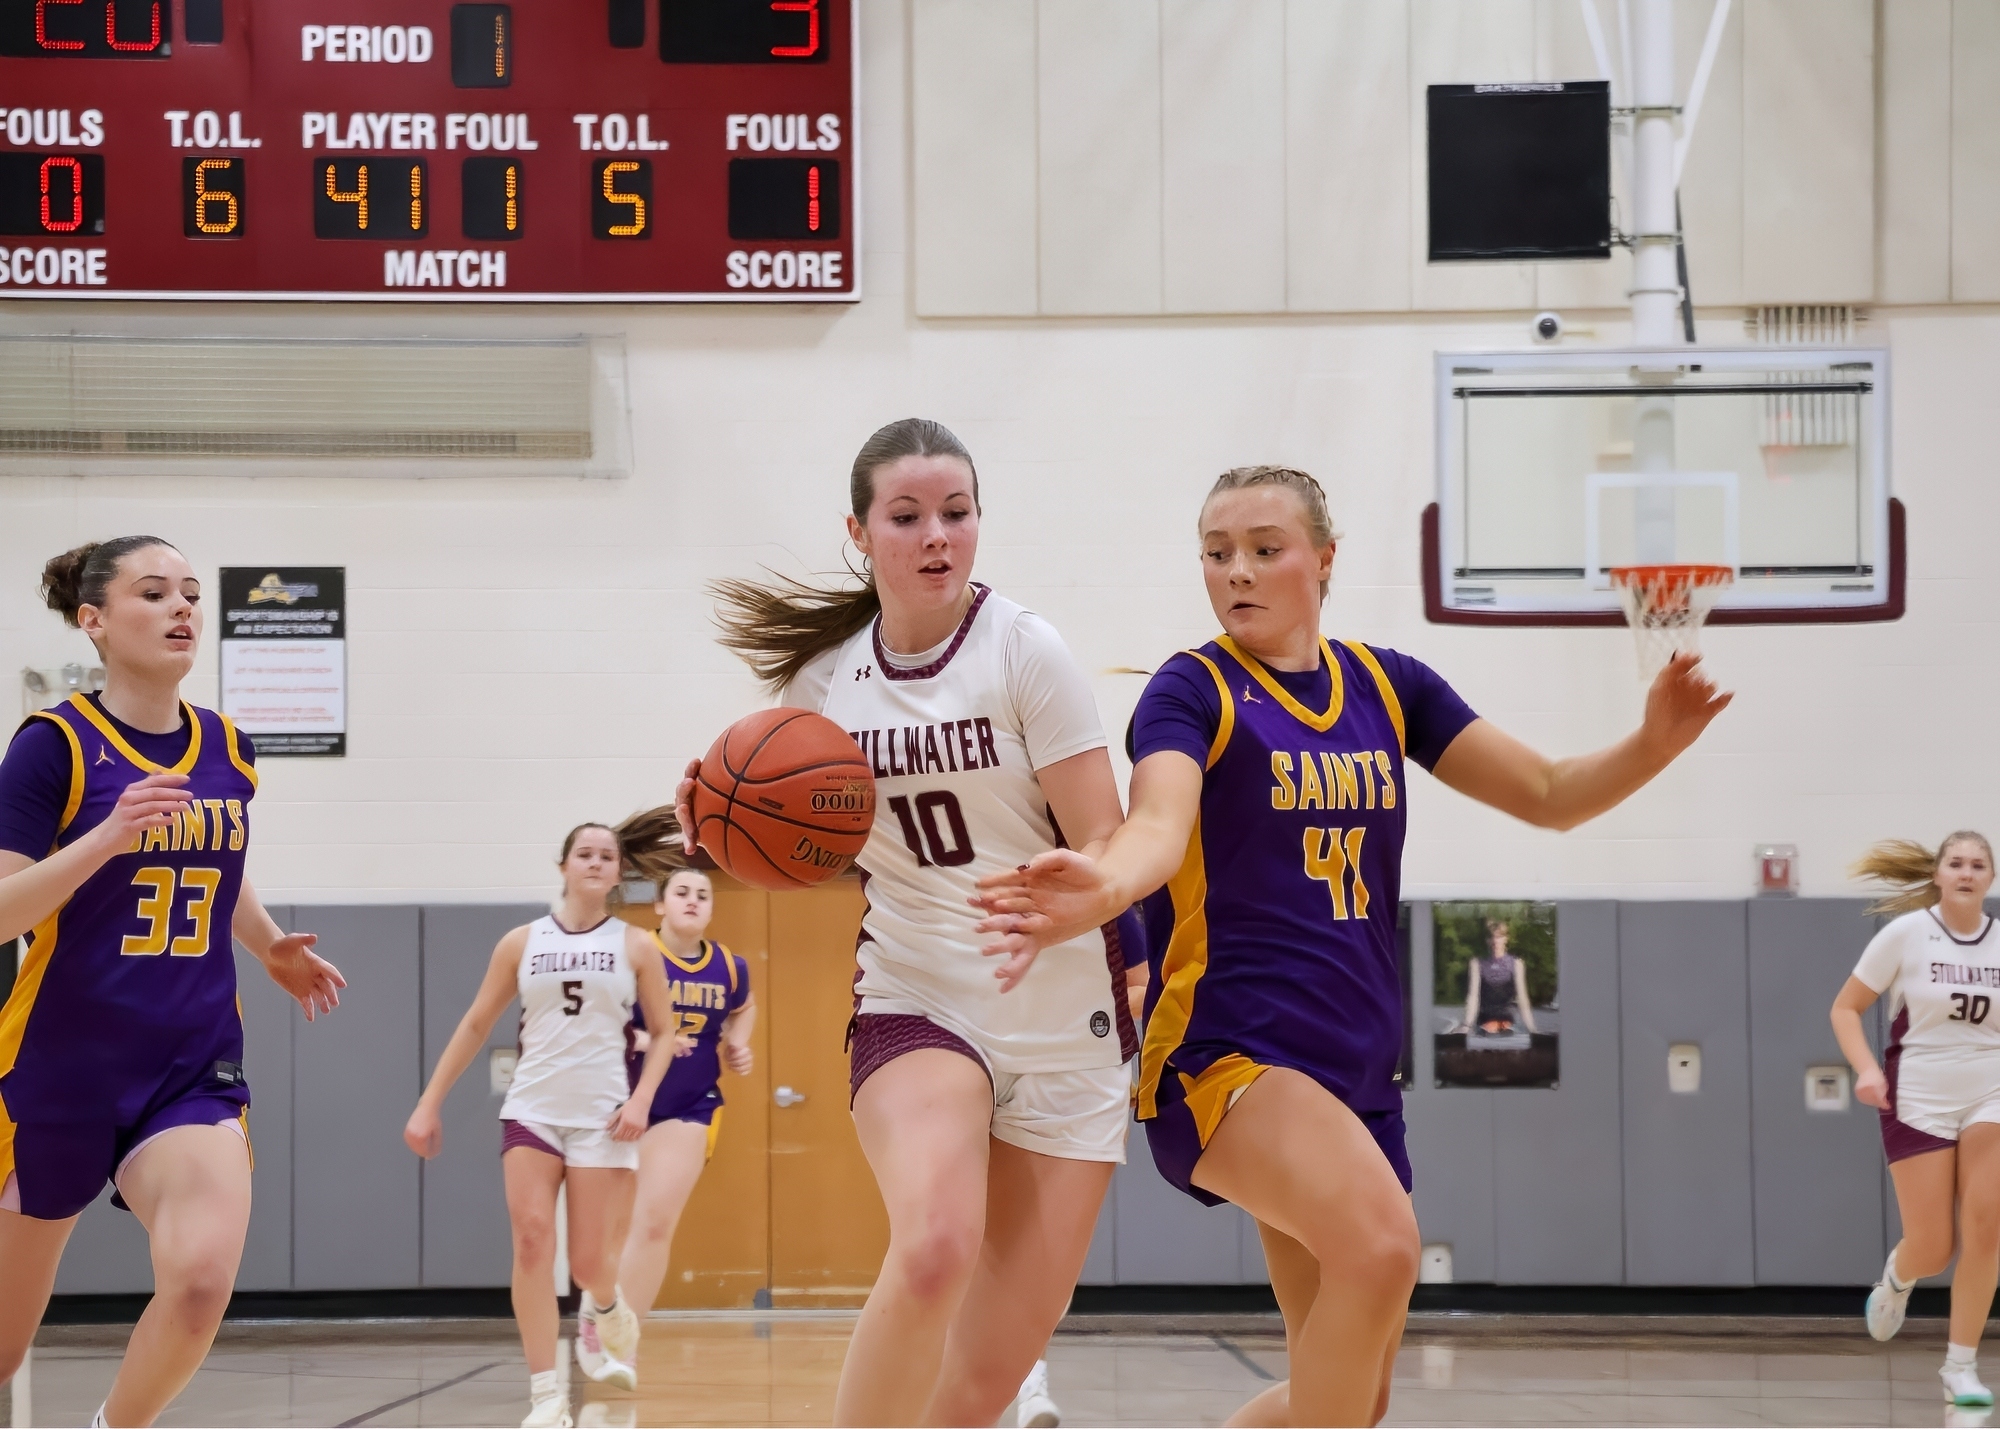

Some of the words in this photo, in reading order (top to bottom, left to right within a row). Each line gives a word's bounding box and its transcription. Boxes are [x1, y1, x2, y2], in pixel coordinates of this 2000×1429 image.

[300, 24, 434, 64] PERIOD
[494, 14, 505, 78] 1
[163, 110, 263, 149] T.O.L.
[301, 111, 437, 150] PLAYER
[444, 112, 539, 151] FOUL
[572, 113, 670, 152] T.O.L.
[726, 113, 842, 152] FOULS
[40, 156, 83, 232] 0
[195, 159, 238, 234] 6
[326, 164, 422, 230] 41
[505, 166, 517, 231] 1
[603, 161, 646, 236] 5
[808, 166, 820, 231] 1
[383, 249, 507, 288] MATCH
[725, 250, 843, 289] SCORE
[849, 716, 1000, 779] ILLWATER
[1271, 750, 1396, 810] SAINTS
[130, 799, 245, 852] AINTS
[887, 789, 975, 868] 10
[790, 836, 843, 869] DING
[1302, 826, 1370, 920] 41
[121, 867, 221, 957] 33
[531, 951, 615, 975] STILLWATER
[1931, 962, 2000, 988] STILLWATE
[562, 980, 583, 1016] 5
[669, 980, 726, 1010] AINTS
[1948, 992, 1990, 1025] 30
